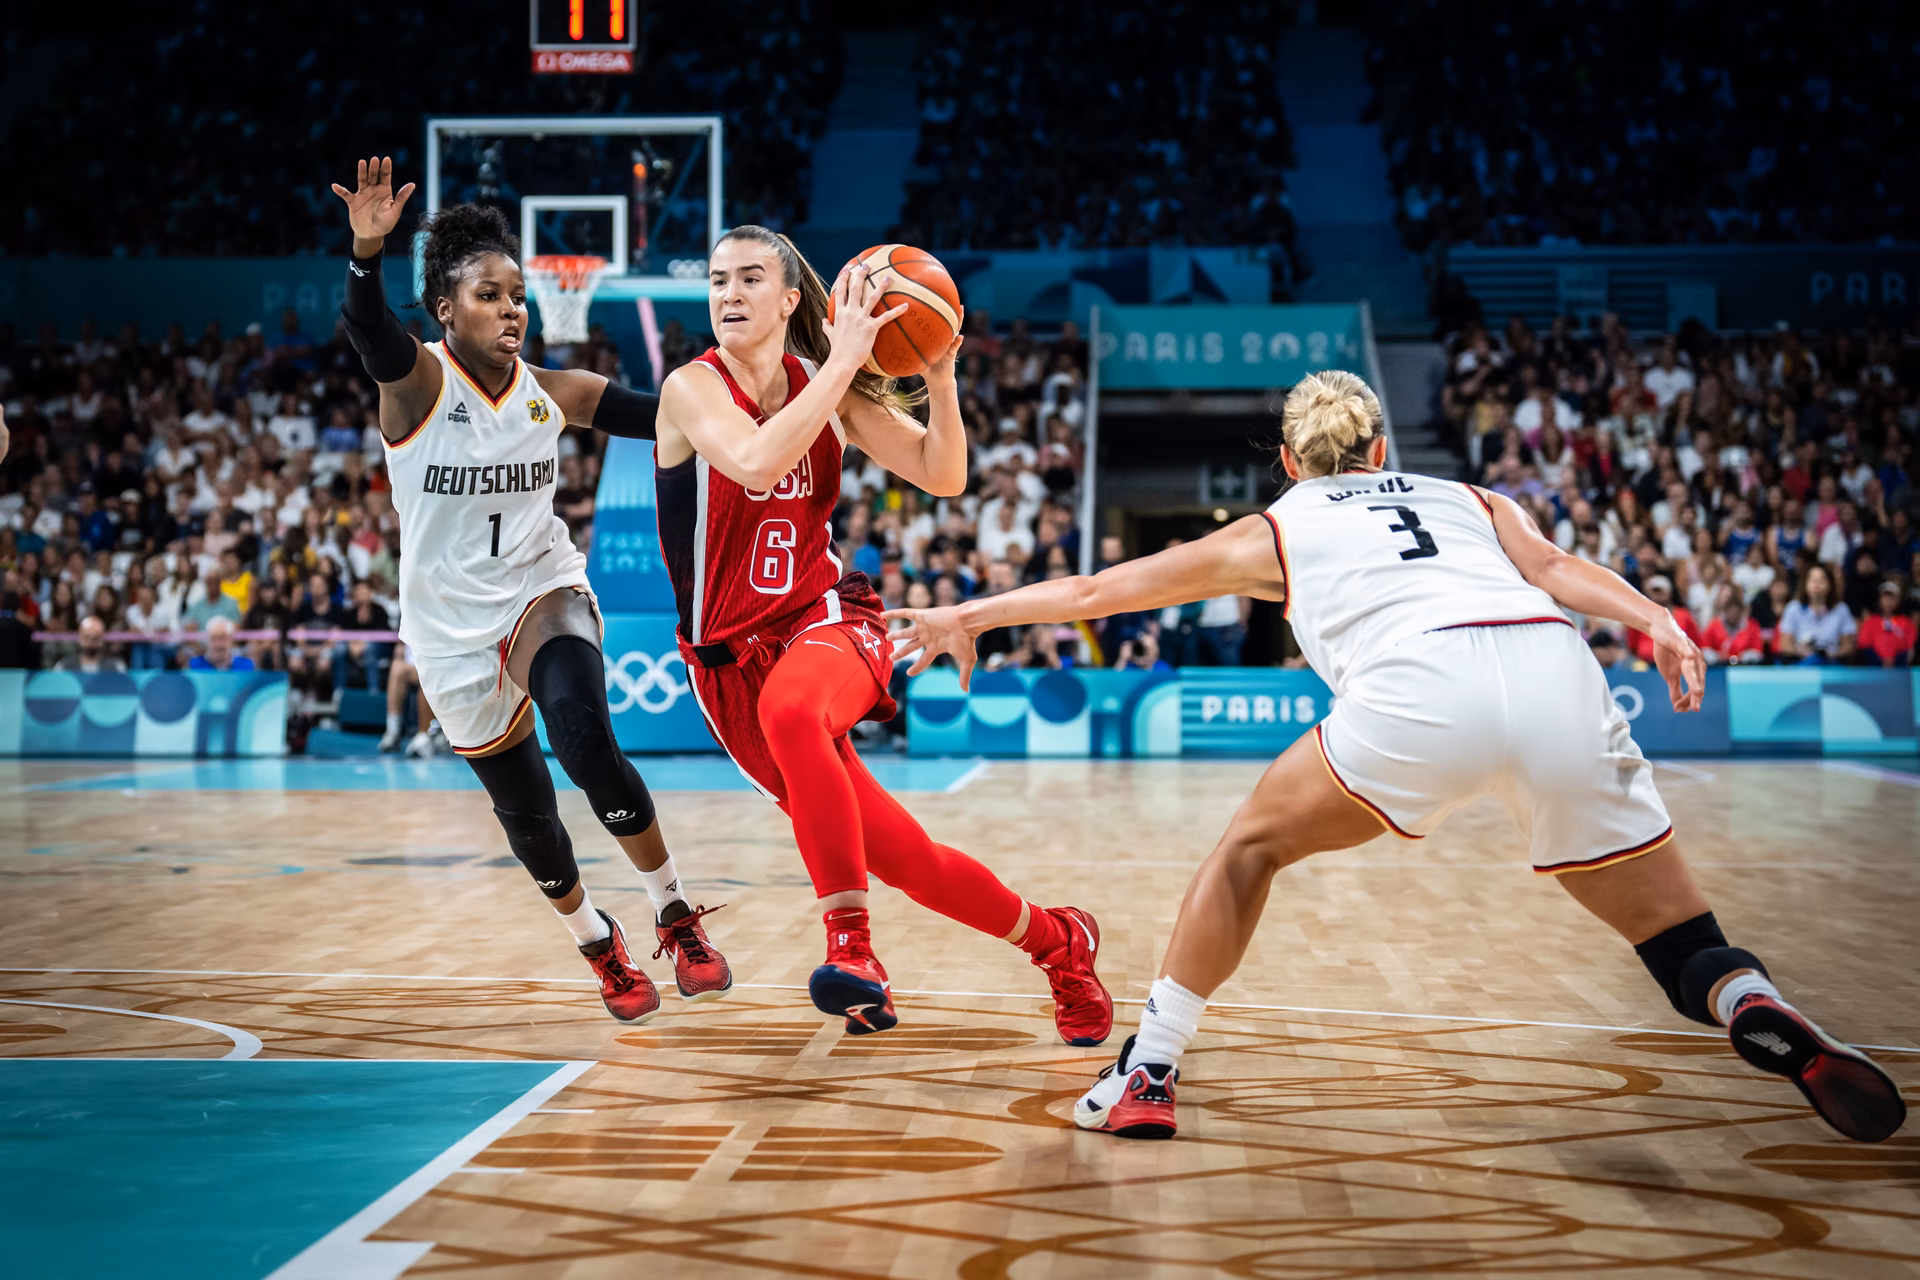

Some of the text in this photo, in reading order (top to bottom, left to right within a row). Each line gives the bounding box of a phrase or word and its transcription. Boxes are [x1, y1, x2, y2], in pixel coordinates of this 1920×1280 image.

[559, 52, 631, 72] OMEGA
[1808, 268, 1920, 307] PAR
[907, 309, 939, 343] PARIS
[1097, 331, 1225, 364] PARIS
[448, 413, 472, 425] PEAK
[423, 457, 555, 496] DEUTSCHLAND
[488, 512, 502, 557] 1
[1366, 505, 1439, 561] 3
[749, 518, 797, 595] 6
[1202, 694, 1316, 724] PARIS
